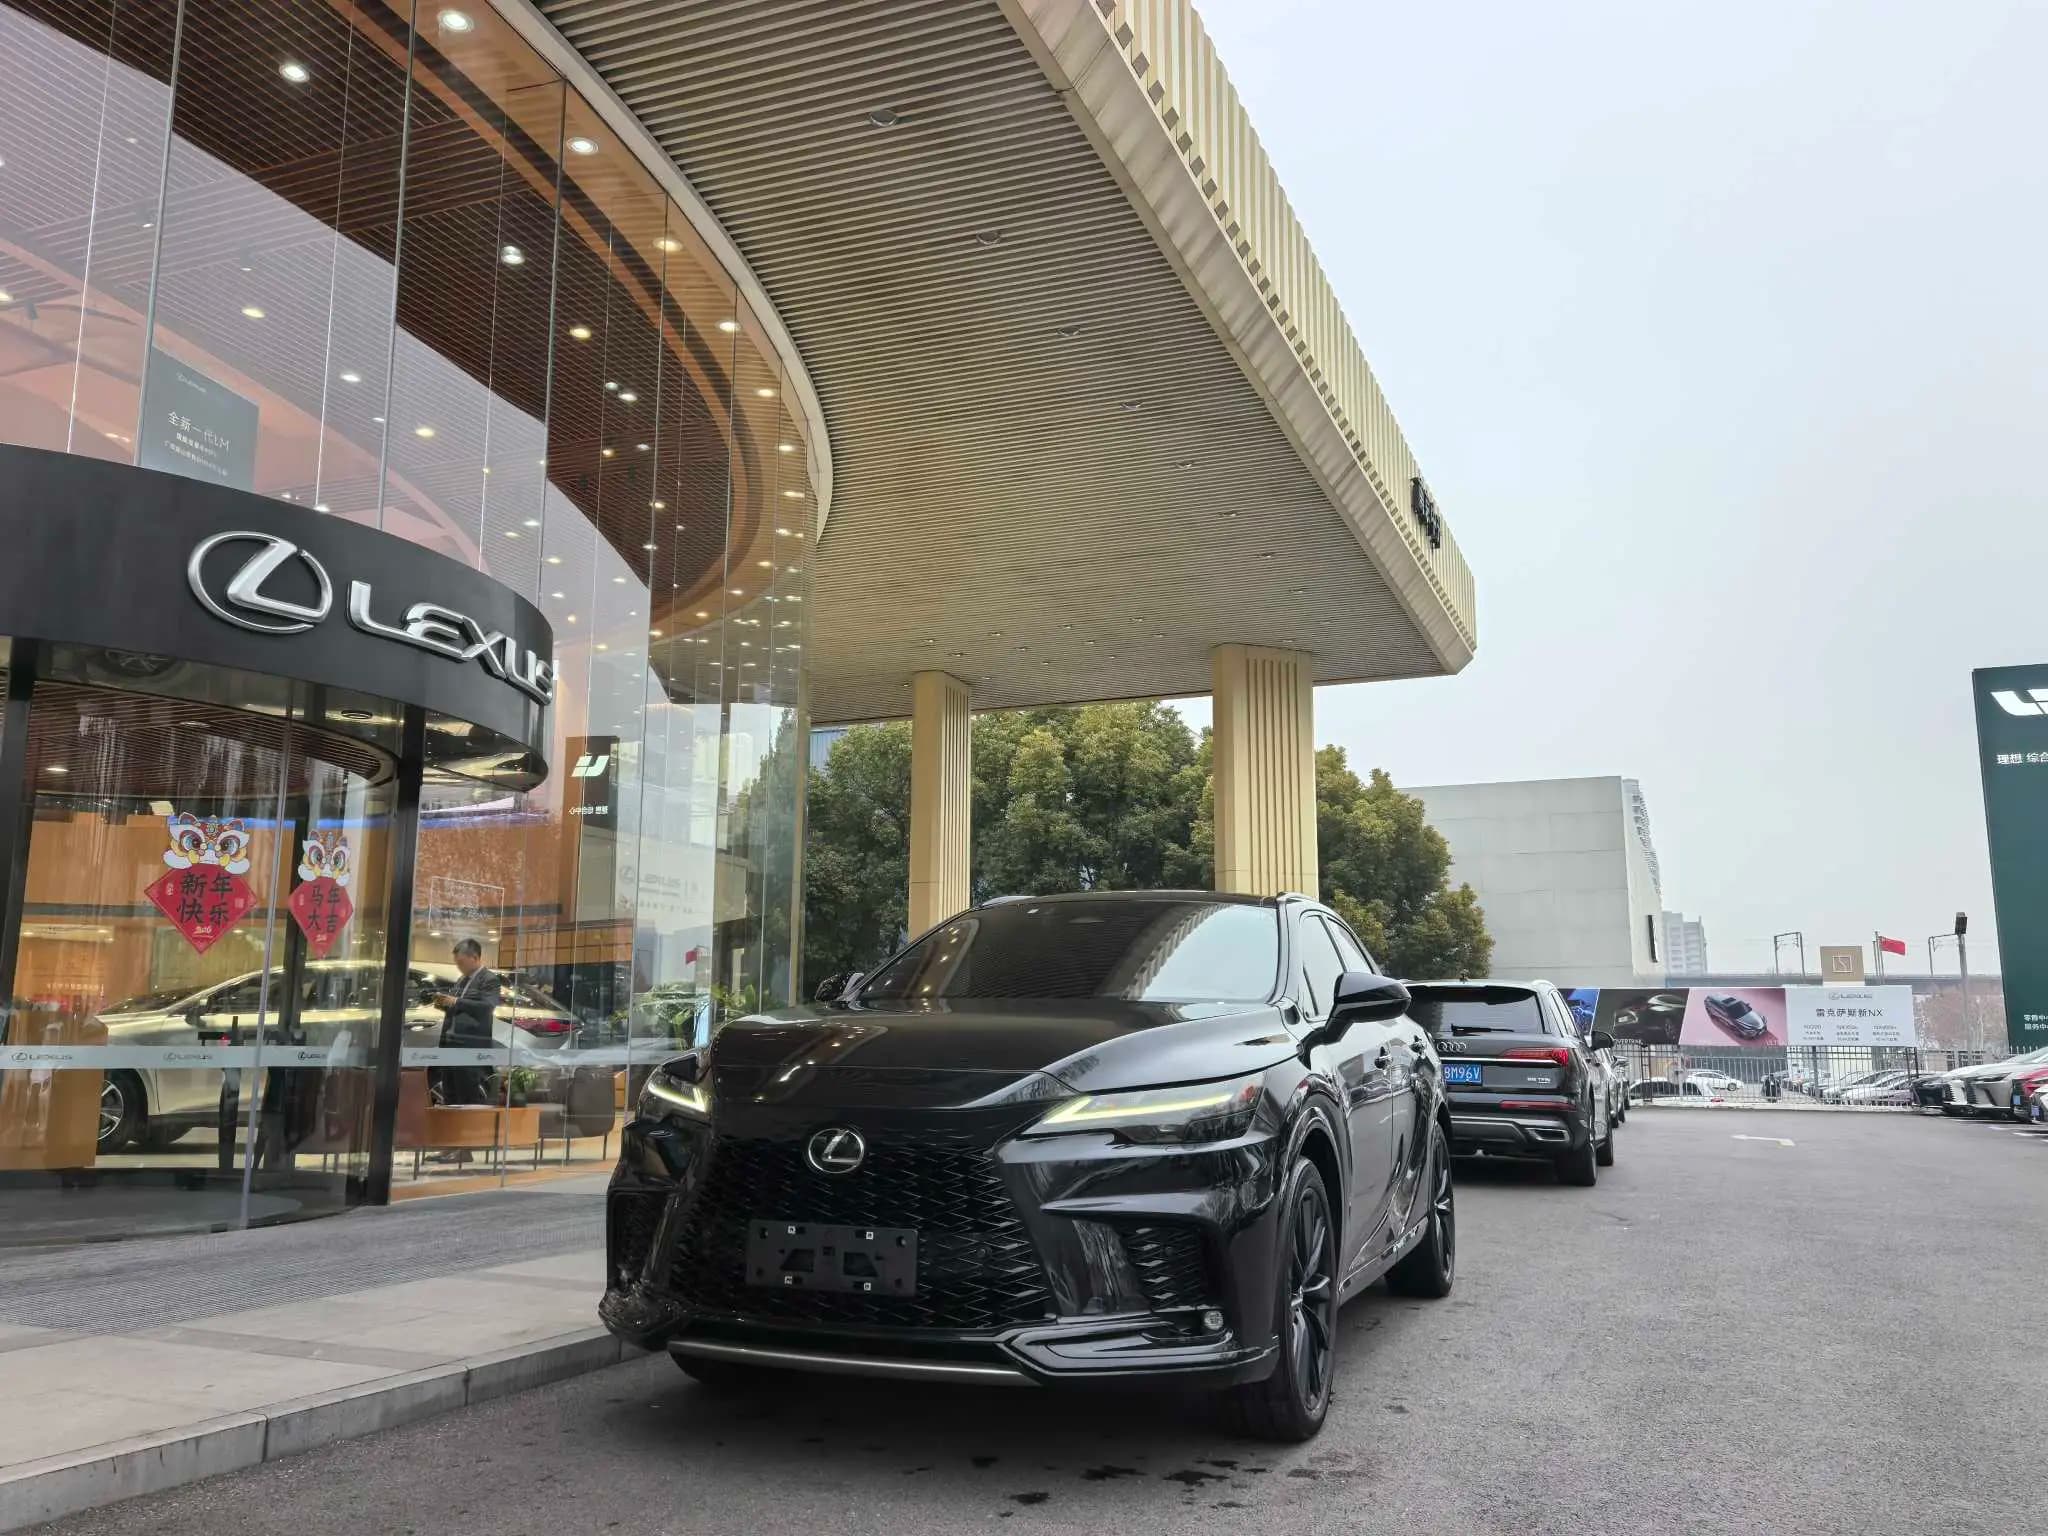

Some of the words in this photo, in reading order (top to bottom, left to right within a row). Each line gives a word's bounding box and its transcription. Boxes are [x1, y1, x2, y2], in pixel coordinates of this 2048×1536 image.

[347, 579, 553, 706] LEXUS
[180, 872, 233, 900] 新年
[176, 899, 230, 927] 快乐
[305, 909, 339, 933] 大吉
[1816, 1008, 1884, 1018] 雷克萨斯新NX
